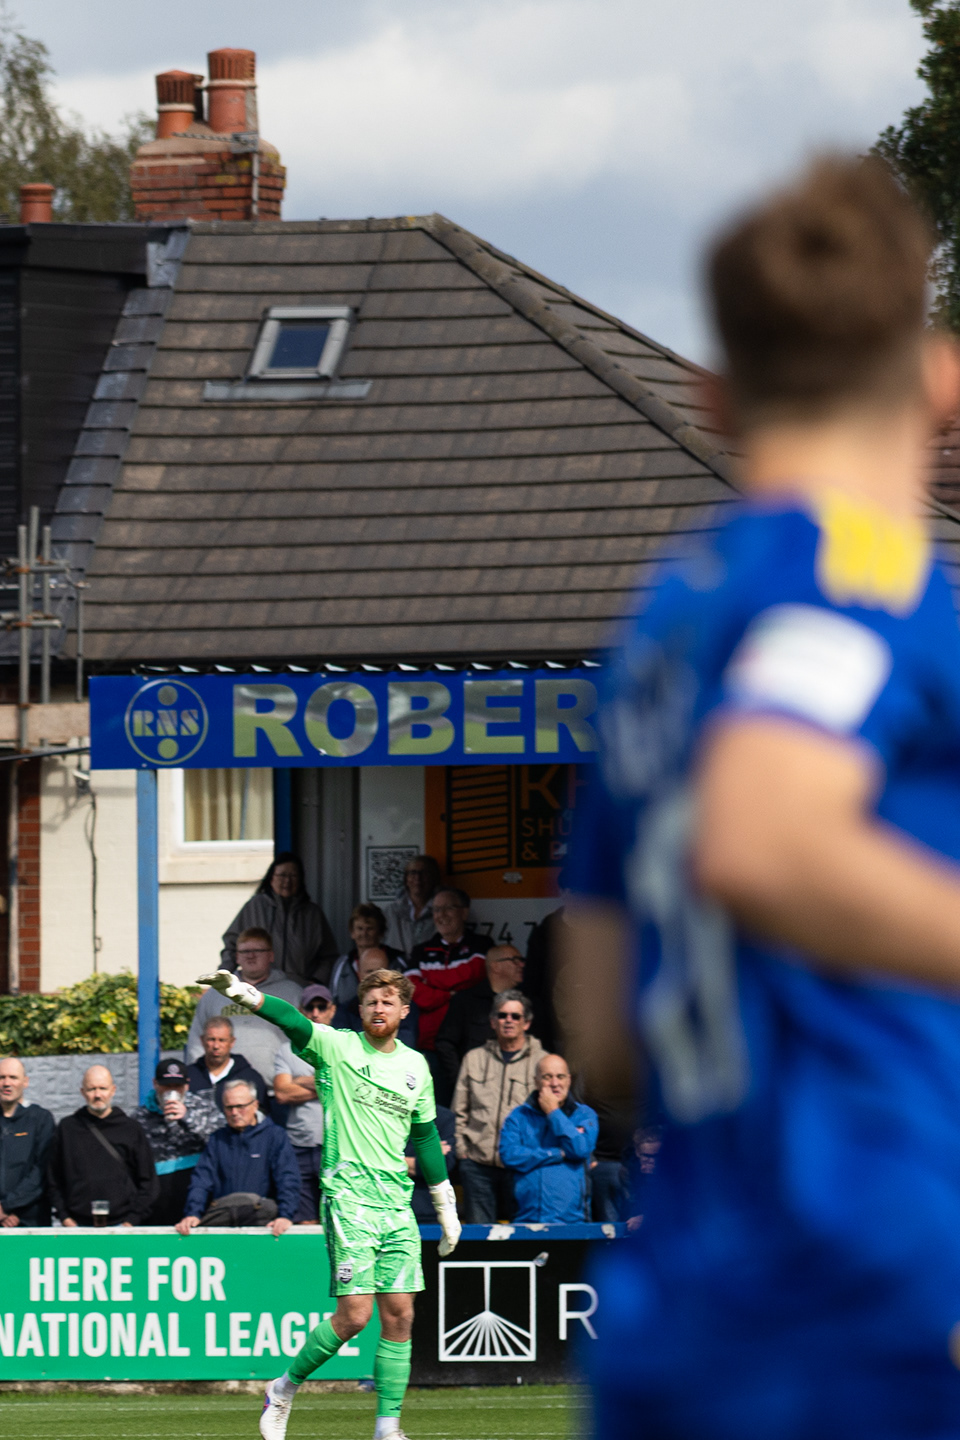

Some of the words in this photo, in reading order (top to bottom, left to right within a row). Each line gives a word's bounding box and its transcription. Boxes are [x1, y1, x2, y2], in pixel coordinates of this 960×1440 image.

[133, 709, 200, 737] RNS
[28, 1256, 134, 1302] HERE
[147, 1255, 228, 1302] FOR
